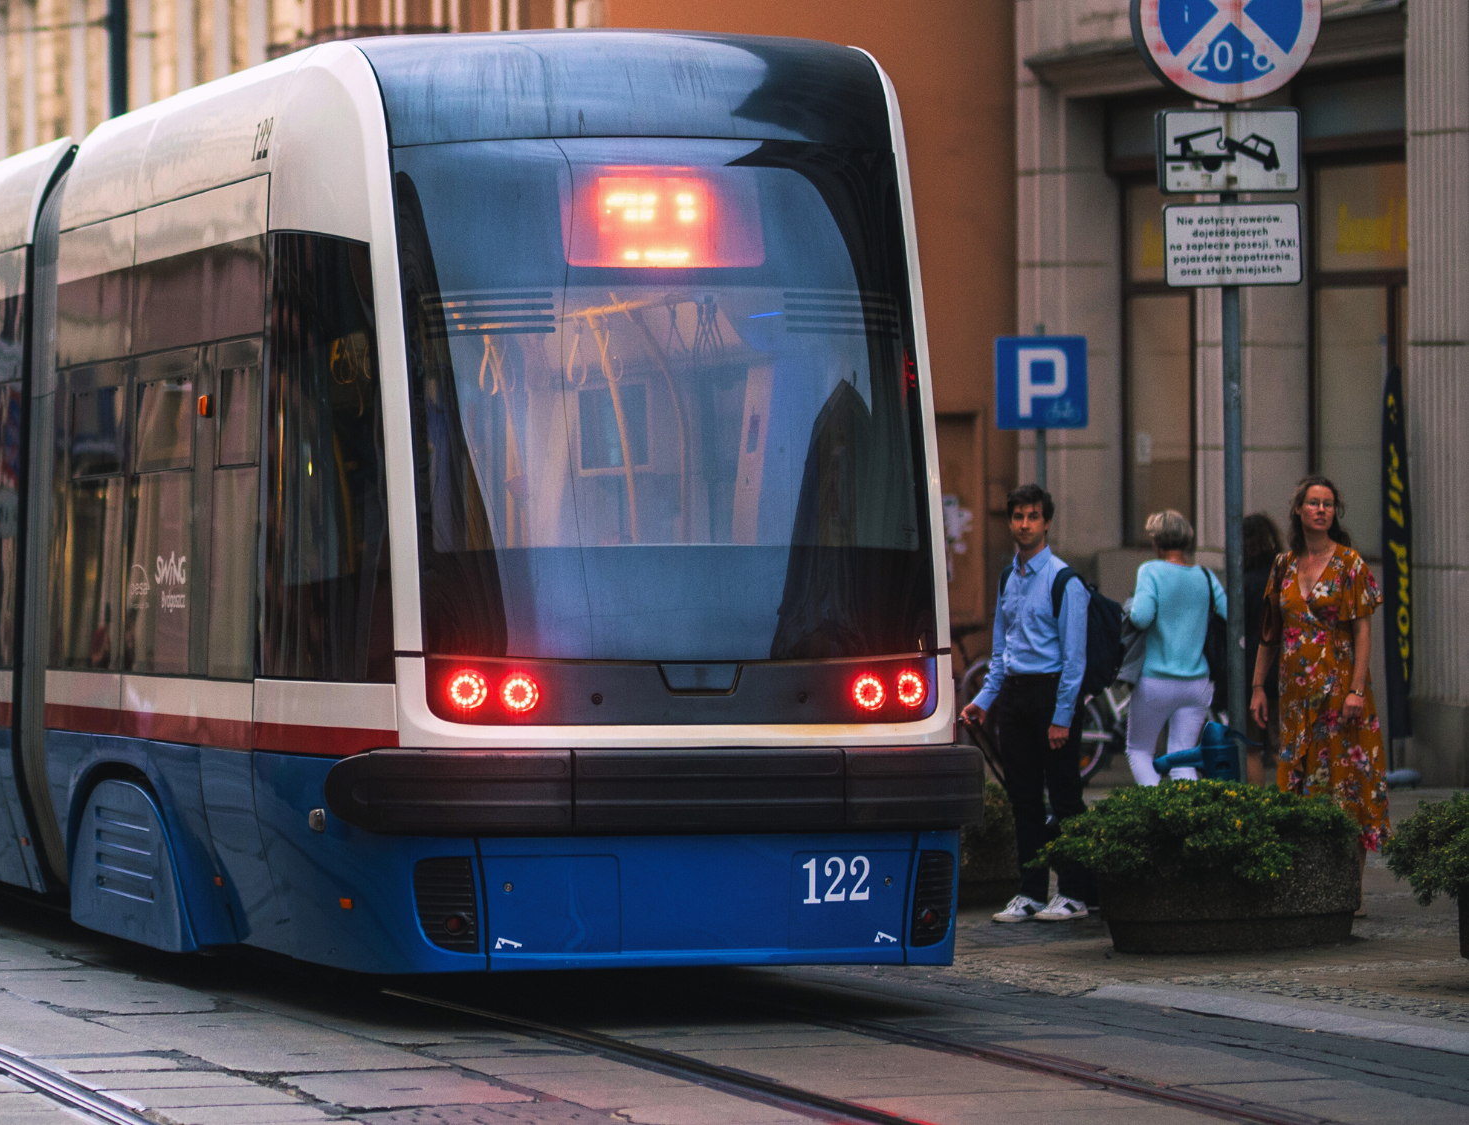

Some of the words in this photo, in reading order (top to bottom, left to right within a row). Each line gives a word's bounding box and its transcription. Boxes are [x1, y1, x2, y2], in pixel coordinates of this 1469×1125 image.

[251, 117, 274, 161] 122
[1177, 216, 1193, 225] Nie
[1198, 216, 1235, 226] dotyczy
[1186, 241, 1230, 252] zaplecze
[1174, 254, 1222, 265] pojazdów
[1181, 268, 1202, 276] oraz
[1206, 265, 1232, 275] służb
[1236, 265, 1282, 276] miejskich
[1018, 348, 1068, 418] P
[802, 855, 871, 904] 122
